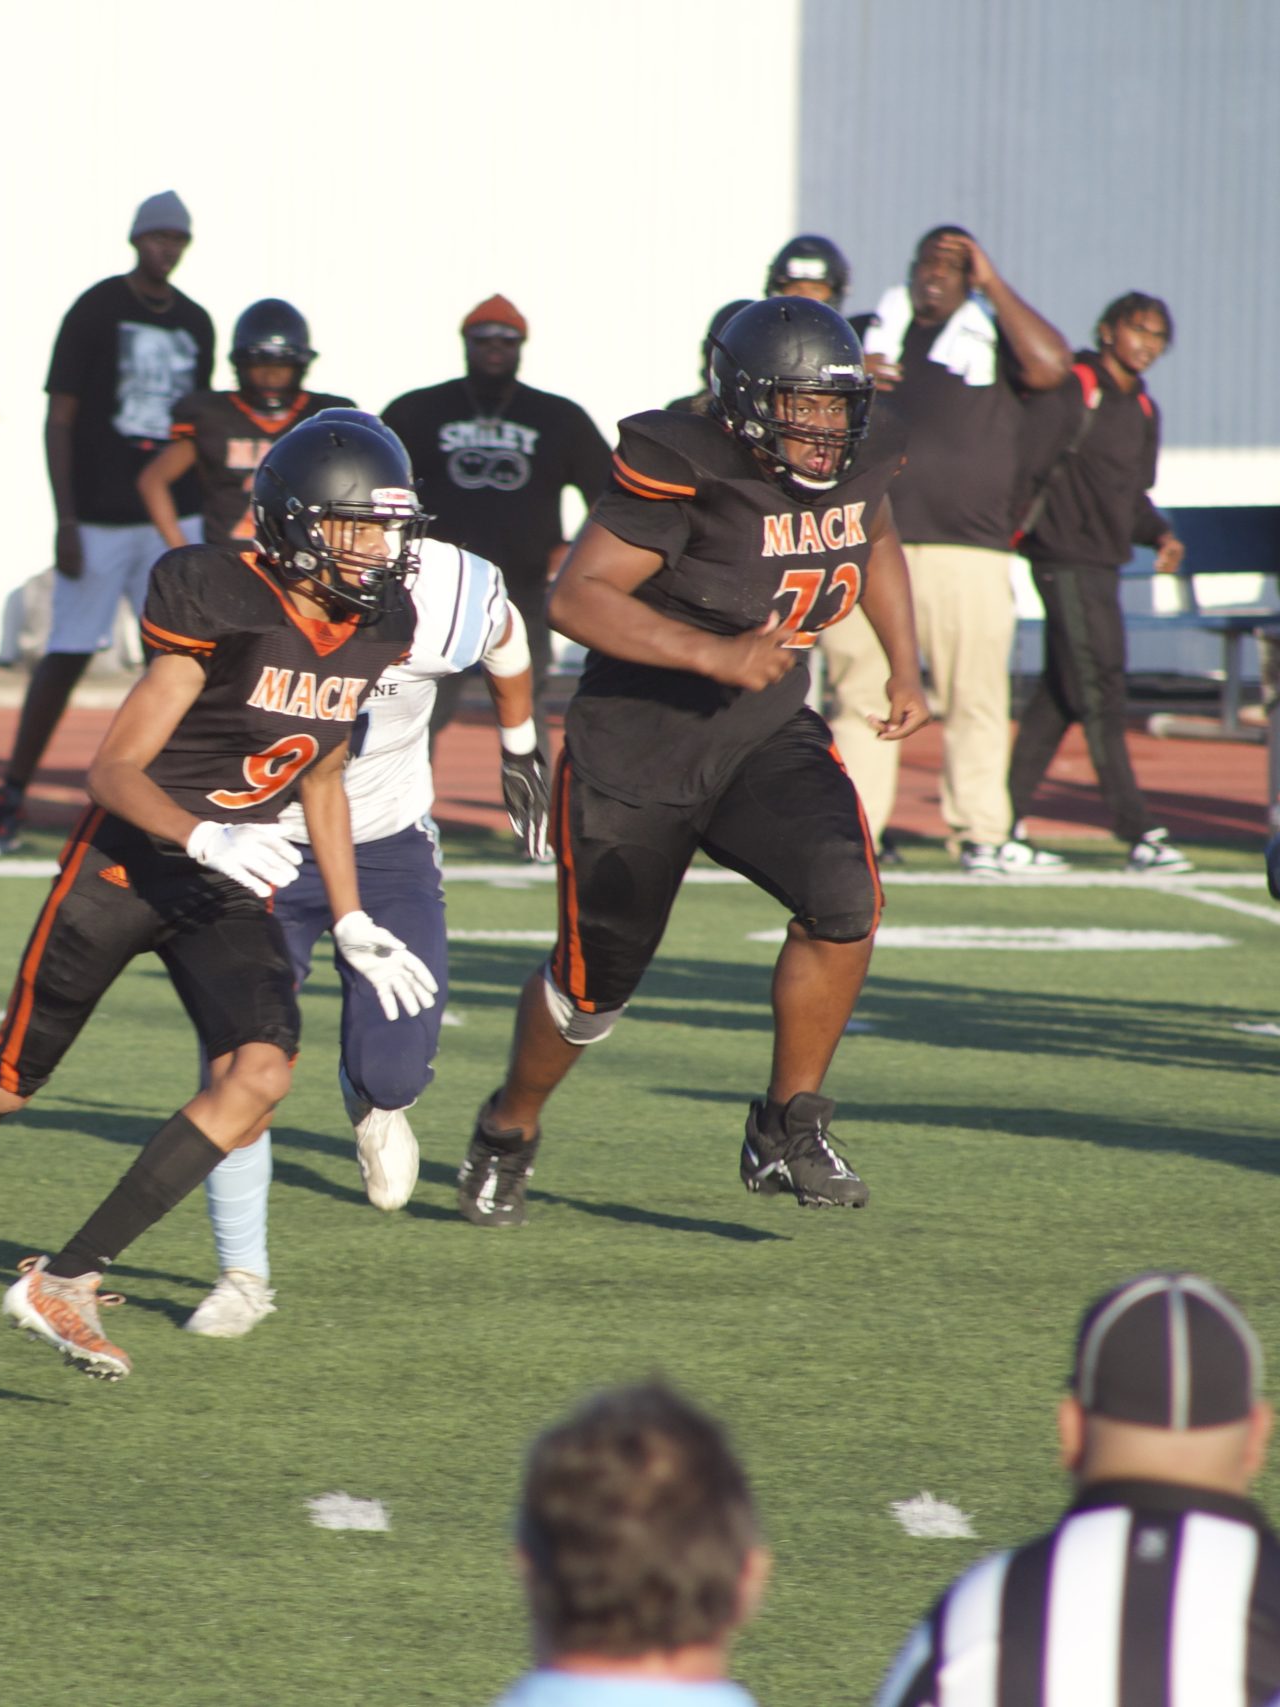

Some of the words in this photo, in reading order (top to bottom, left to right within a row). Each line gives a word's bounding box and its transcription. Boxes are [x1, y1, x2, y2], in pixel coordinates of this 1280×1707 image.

[761, 502, 867, 557] MACK
[773, 562, 861, 648] 72
[246, 666, 368, 722] MACK
[205, 733, 320, 810] 9
